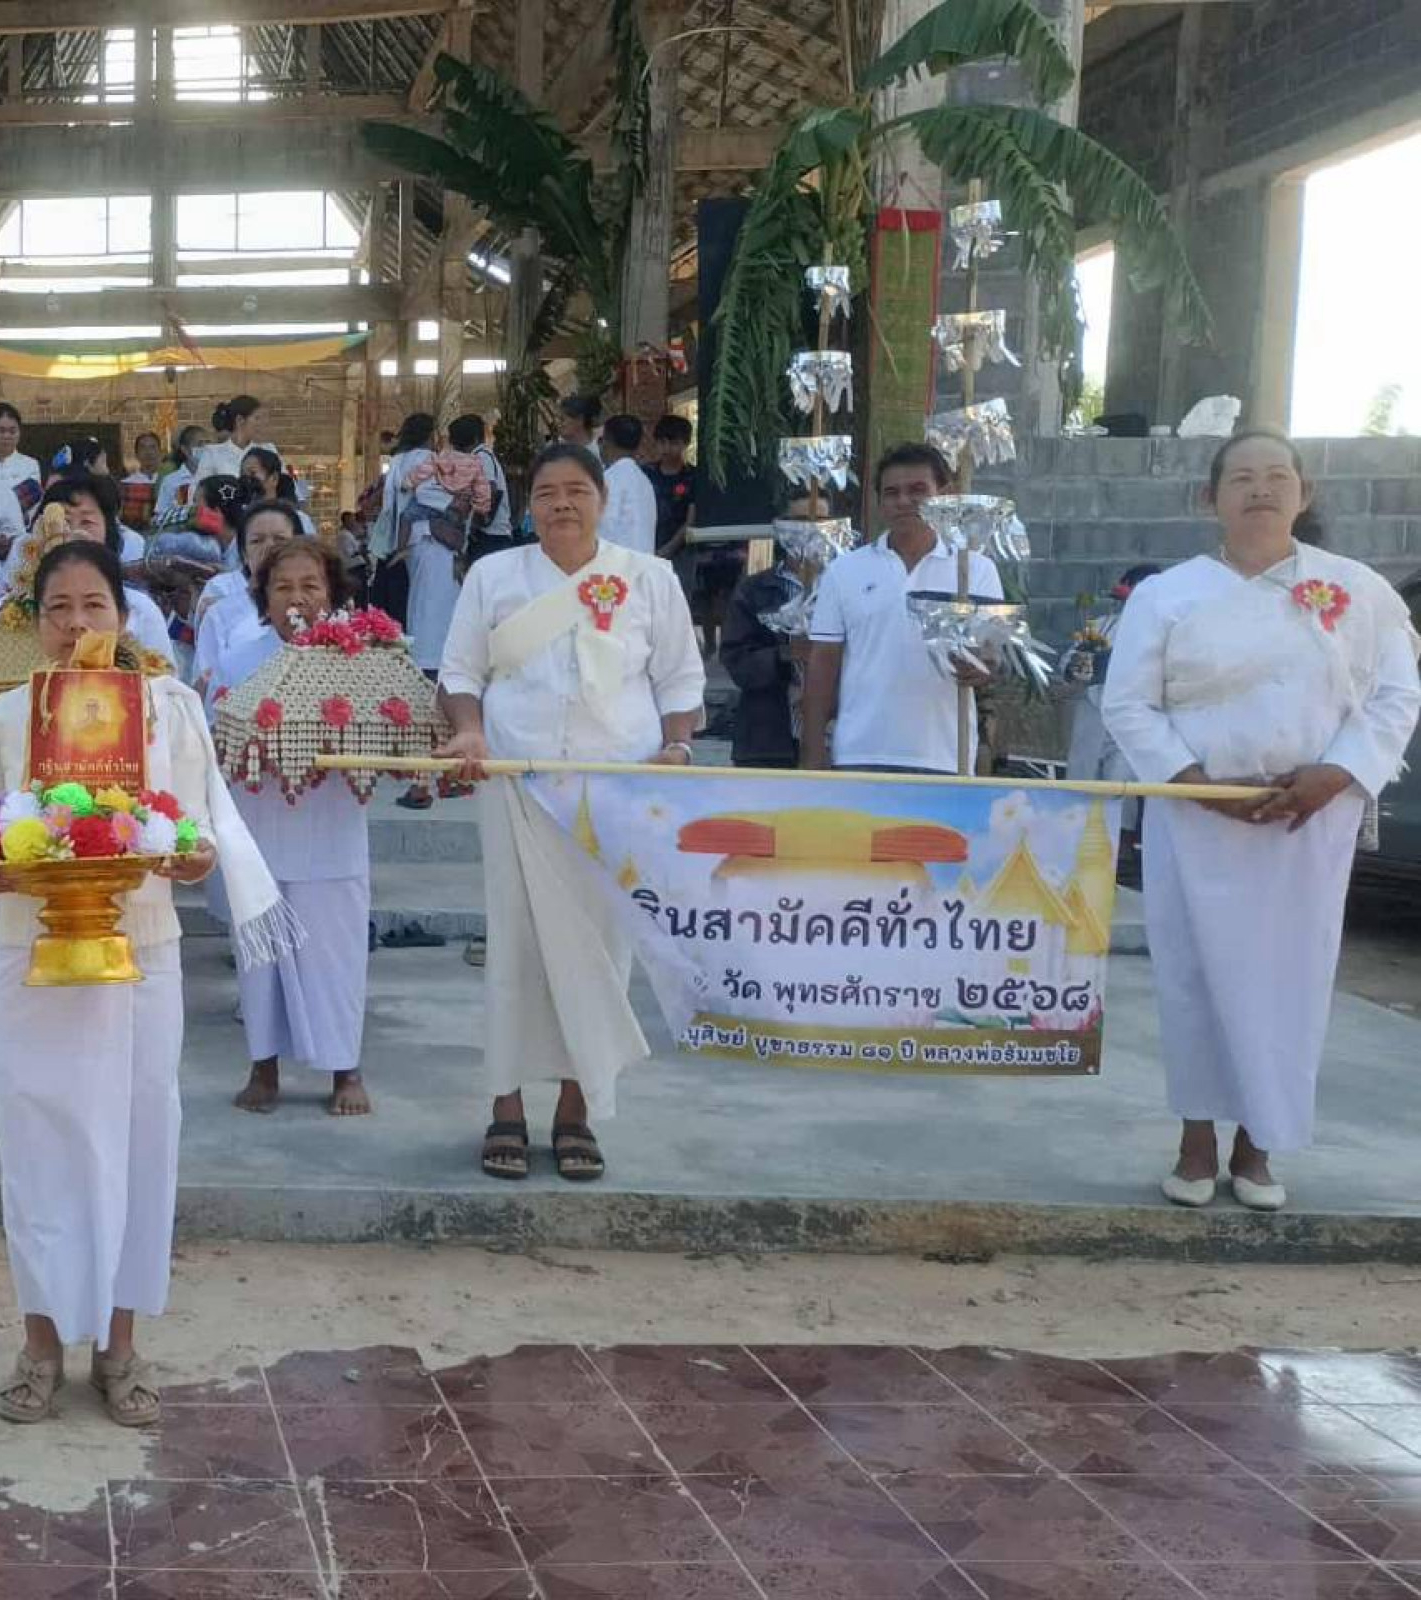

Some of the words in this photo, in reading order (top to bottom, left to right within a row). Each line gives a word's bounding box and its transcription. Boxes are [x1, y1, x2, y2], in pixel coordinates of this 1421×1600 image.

[722, 968, 762, 1000] วัด
[772, 974, 941, 1014] พุทธศักราช
[957, 976, 1092, 1012] ๒๕๖๘
[900, 1038, 915, 1060] ปี
